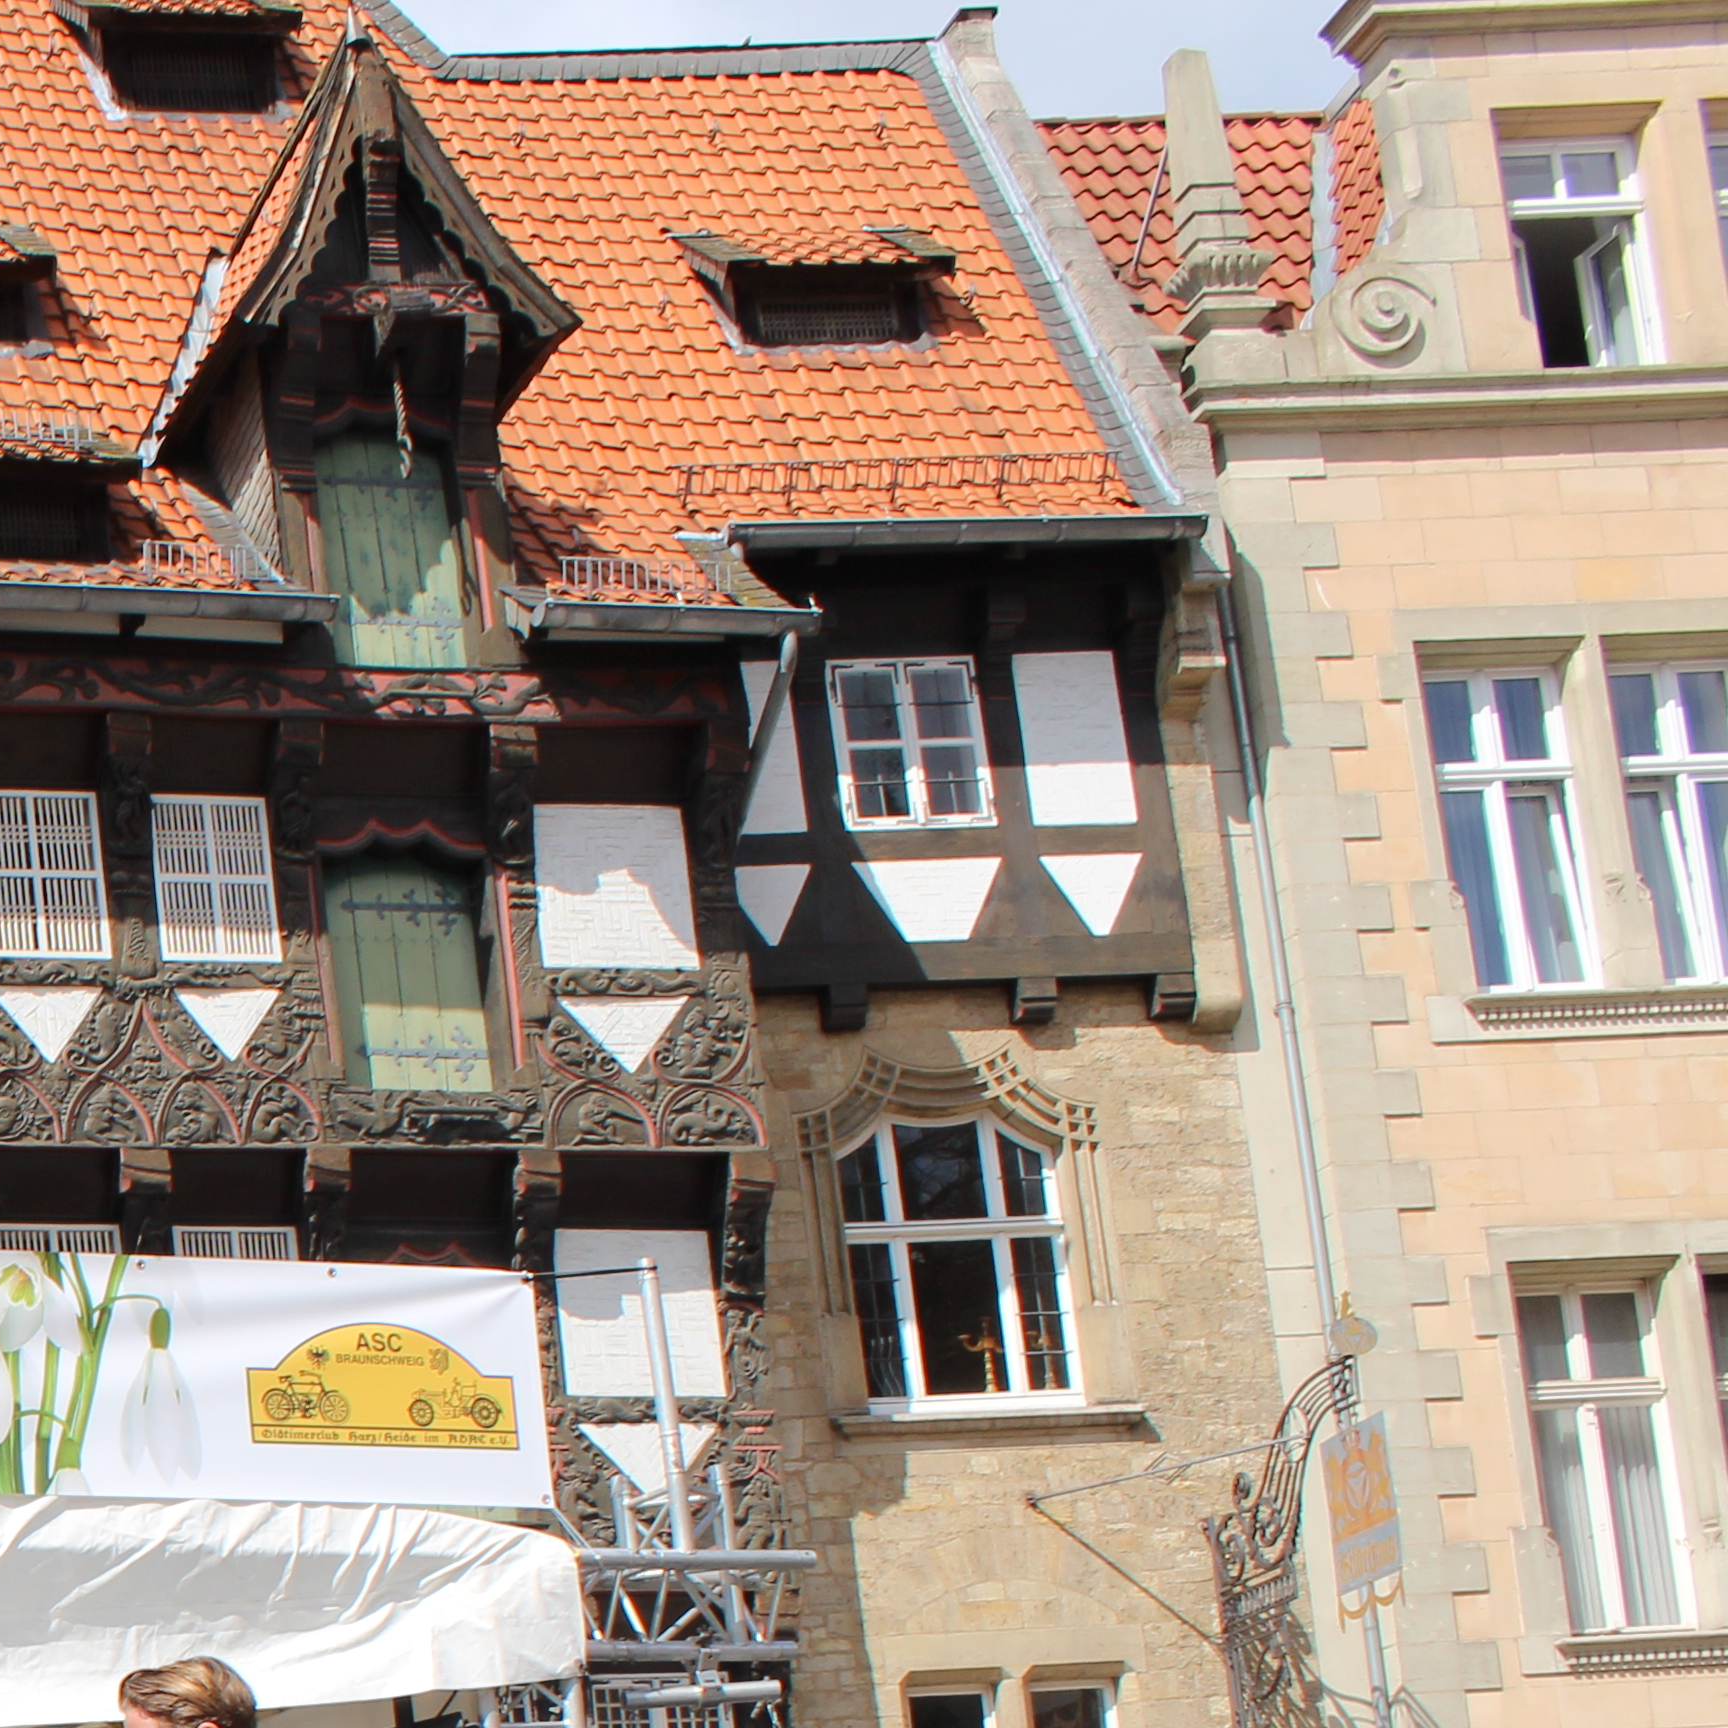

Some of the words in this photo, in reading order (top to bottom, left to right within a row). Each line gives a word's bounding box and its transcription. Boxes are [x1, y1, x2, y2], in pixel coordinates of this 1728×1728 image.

[355, 1332, 402, 1352] ASC
[335, 1353, 425, 1367] BRAUNSCHWEIG
[261, 1429, 340, 1441] Oldtimerclub
[424, 1432, 439, 1443] im
[447, 1433, 487, 1445] ADAC
